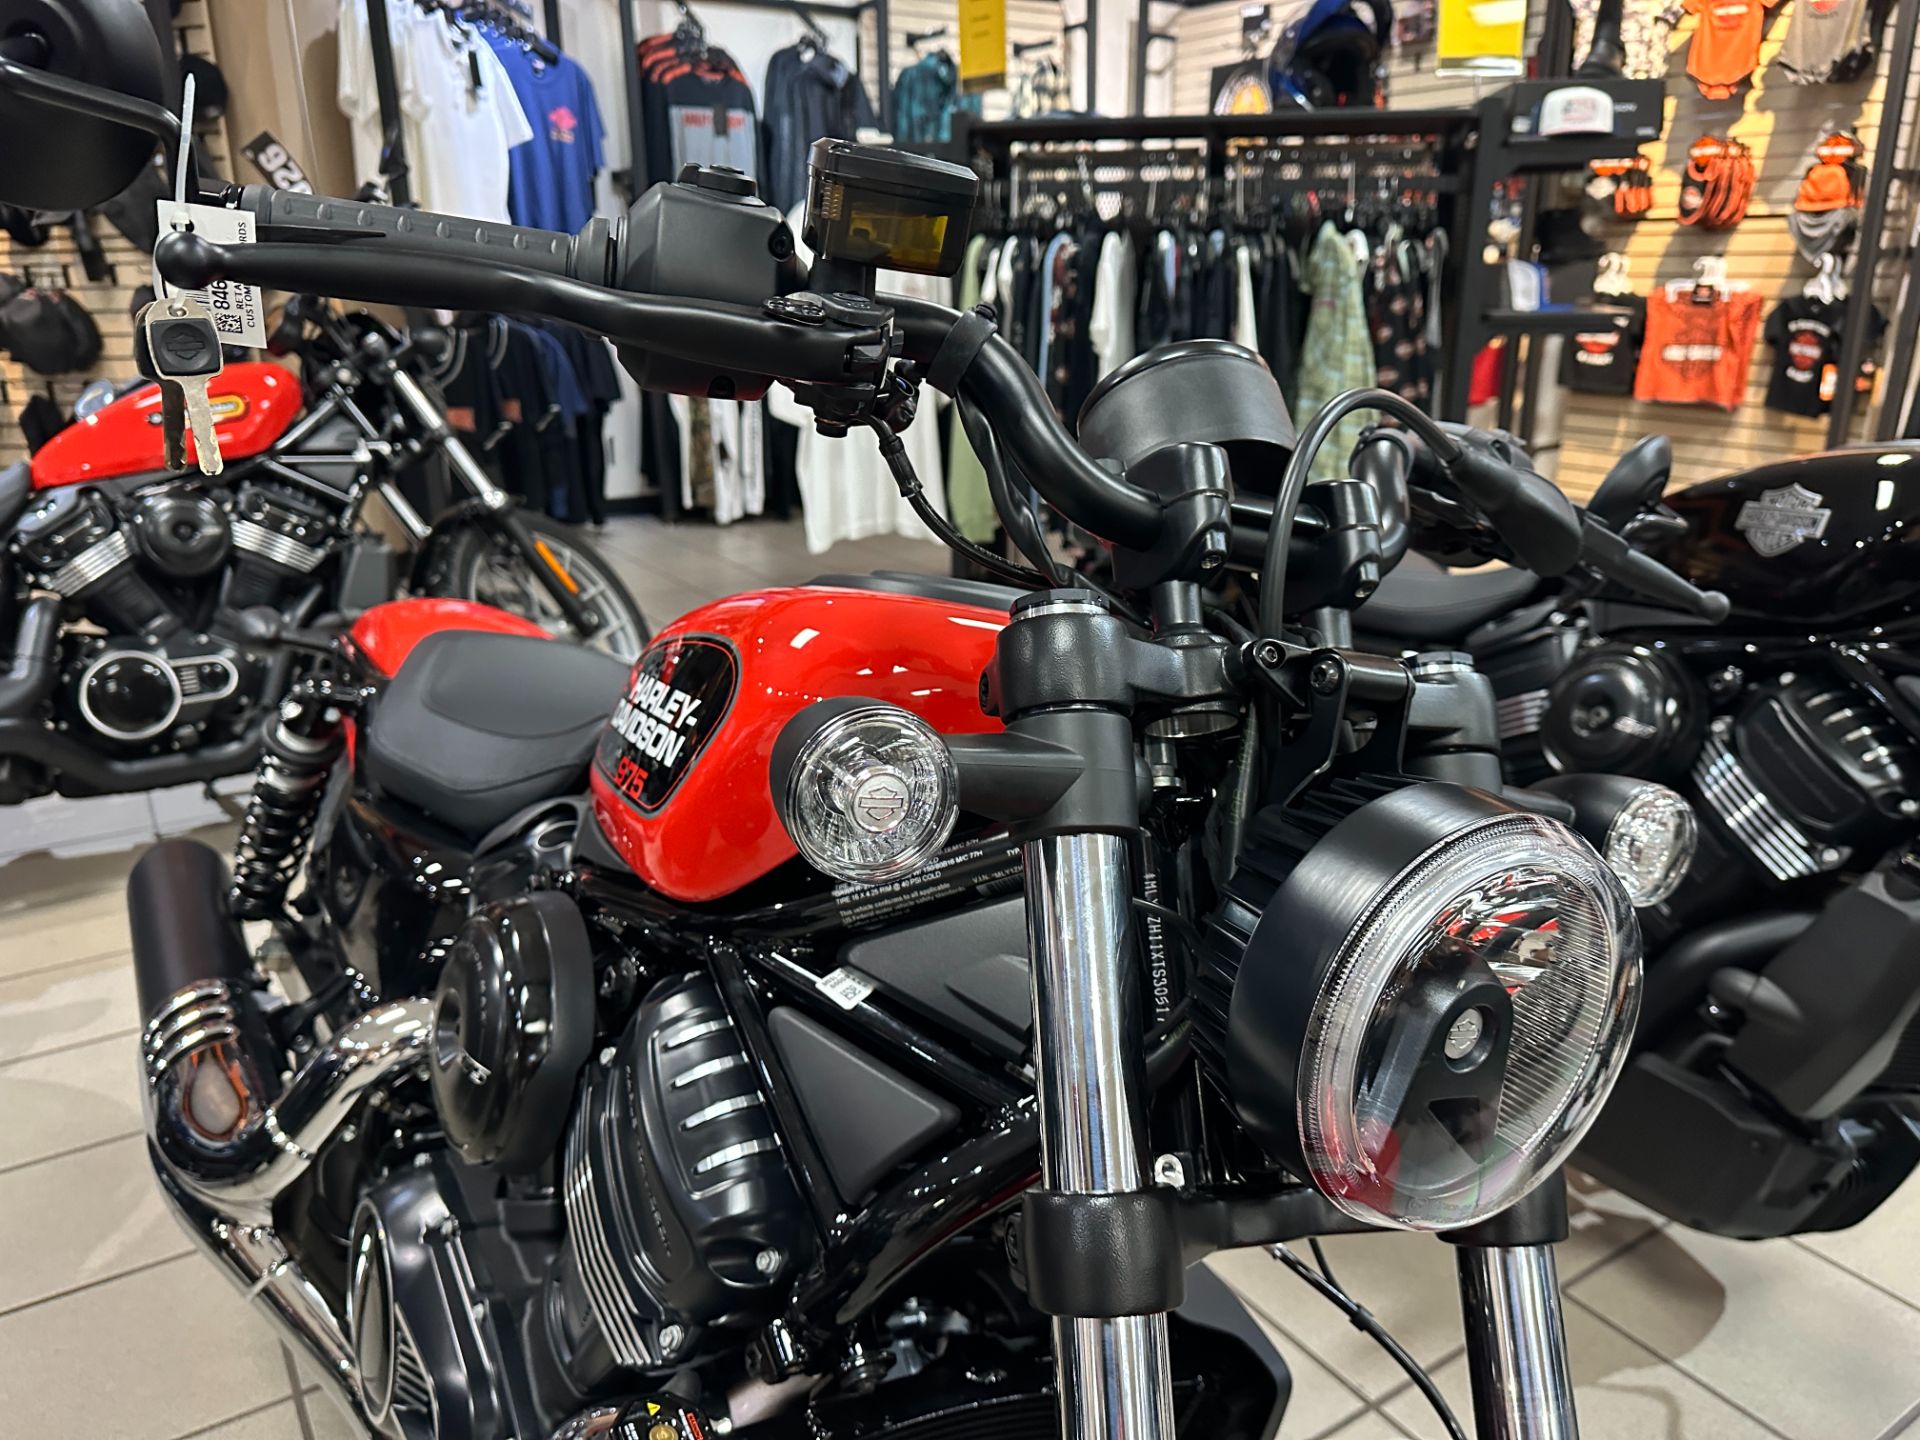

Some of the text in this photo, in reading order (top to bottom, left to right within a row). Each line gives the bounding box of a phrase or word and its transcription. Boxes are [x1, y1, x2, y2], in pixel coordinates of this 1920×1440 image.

[629, 671, 702, 729] HARLEY-
[610, 698, 686, 768] DAVIDSON
[614, 756, 648, 800] 975
[968, 849, 983, 859] 77H
[900, 879, 909, 887] 40
[909, 876, 921, 884] PSI
[921, 870, 941, 881] COLD
